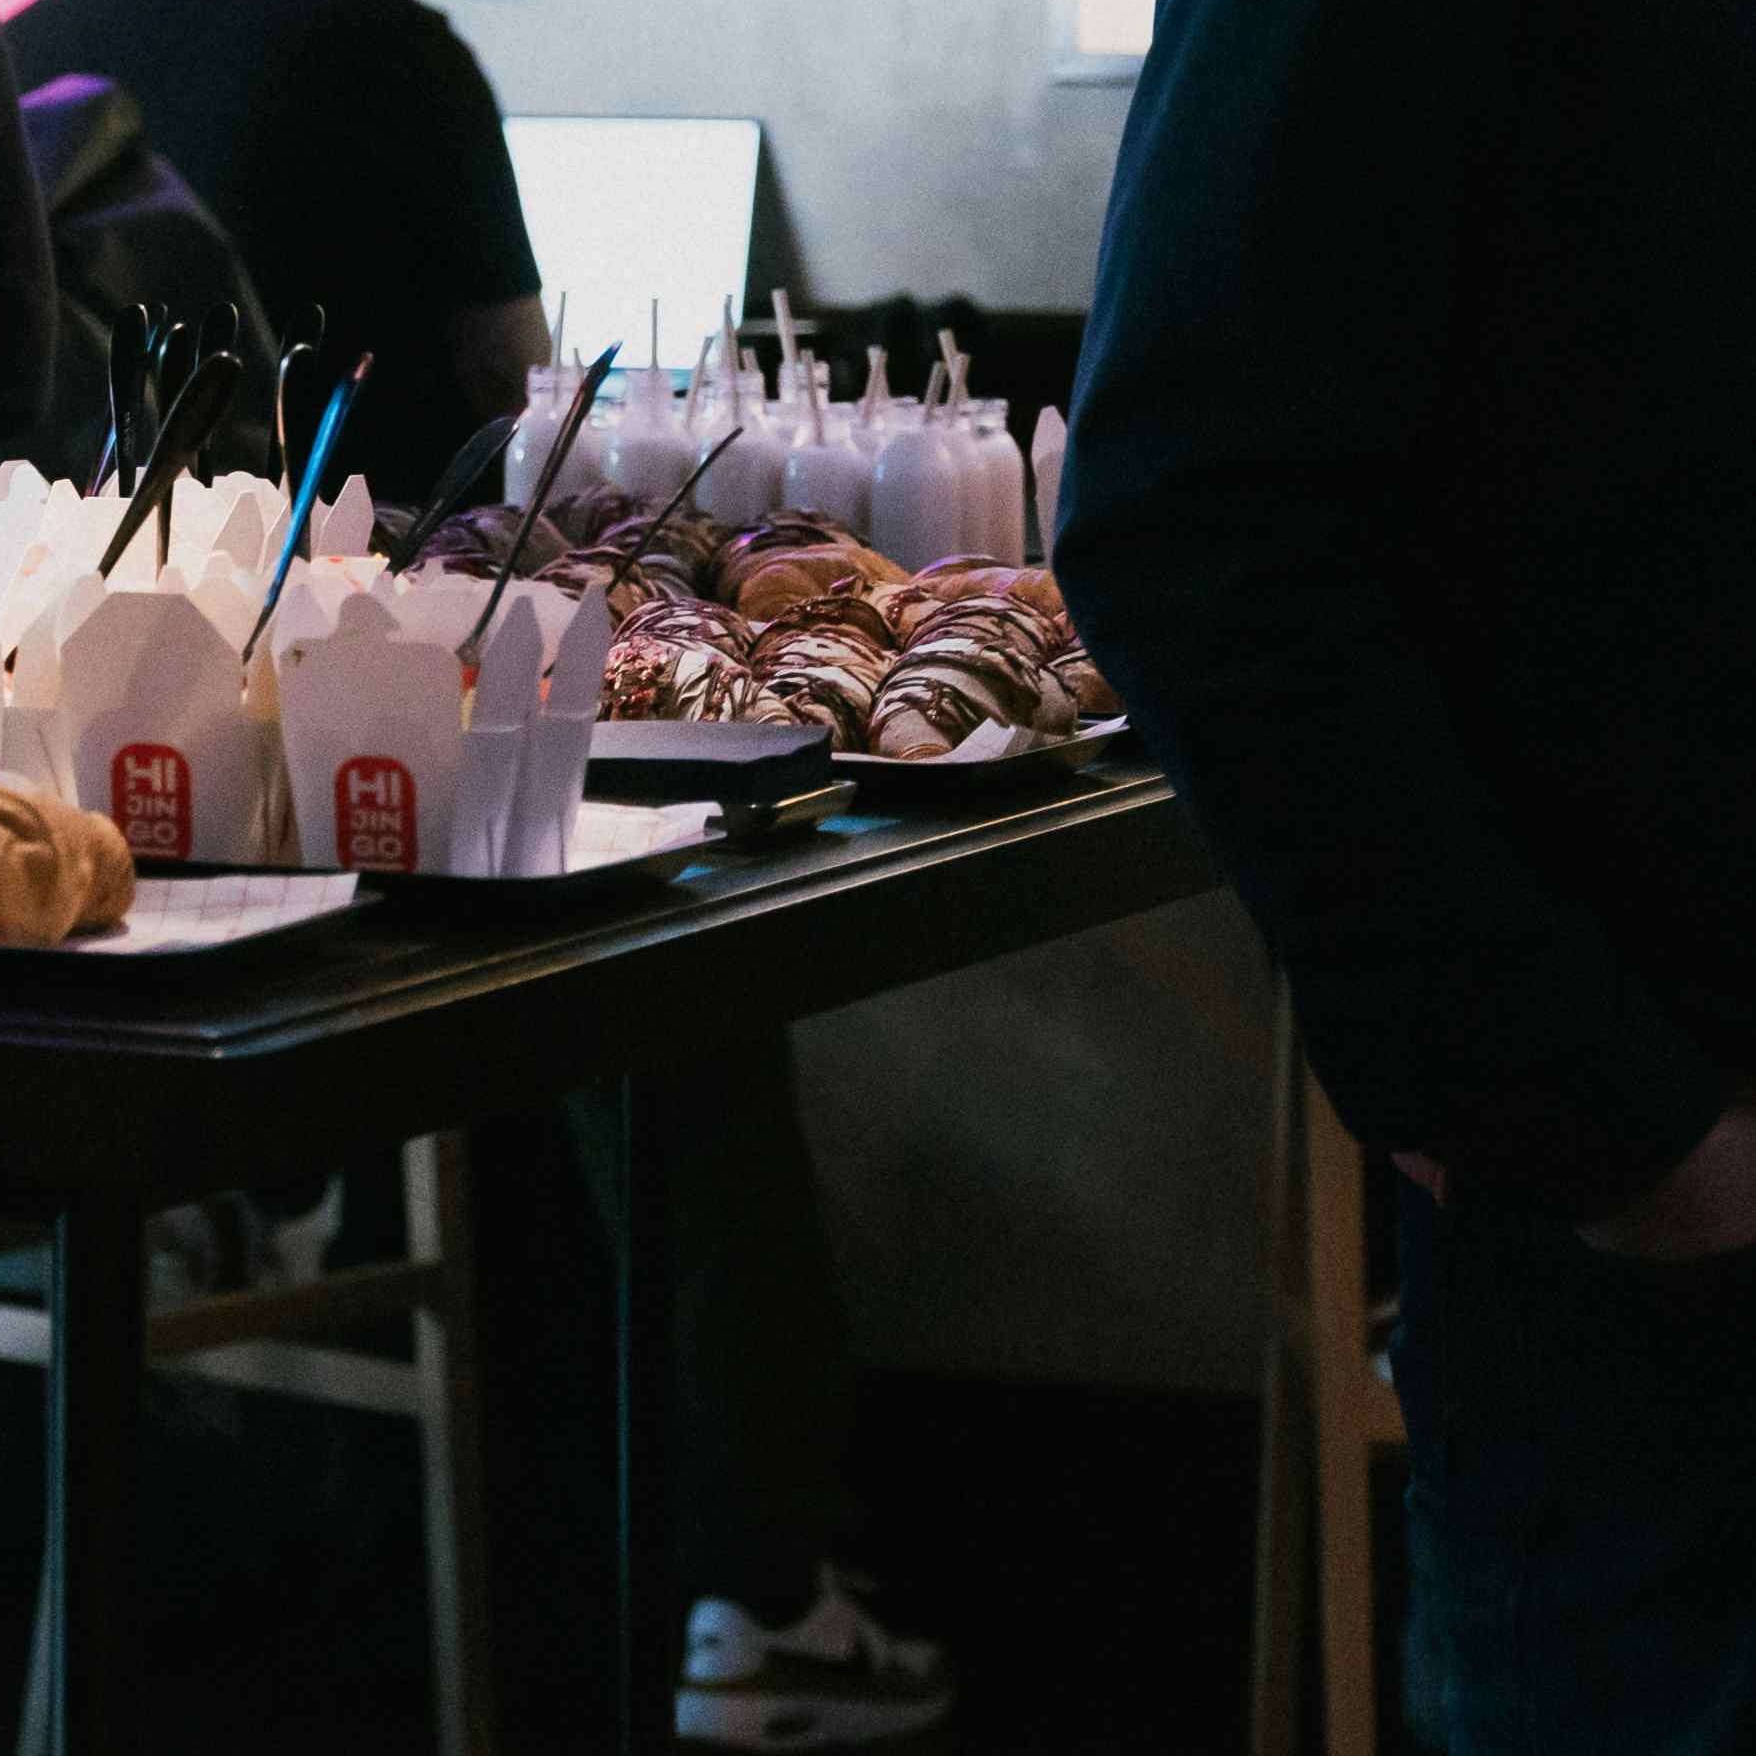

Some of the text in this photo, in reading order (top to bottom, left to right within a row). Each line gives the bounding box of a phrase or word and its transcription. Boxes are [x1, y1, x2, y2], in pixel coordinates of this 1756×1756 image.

[123, 754, 178, 793] HI
[347, 768, 402, 806] HI
[125, 794, 178, 817] JIN
[349, 808, 402, 833] JIN
